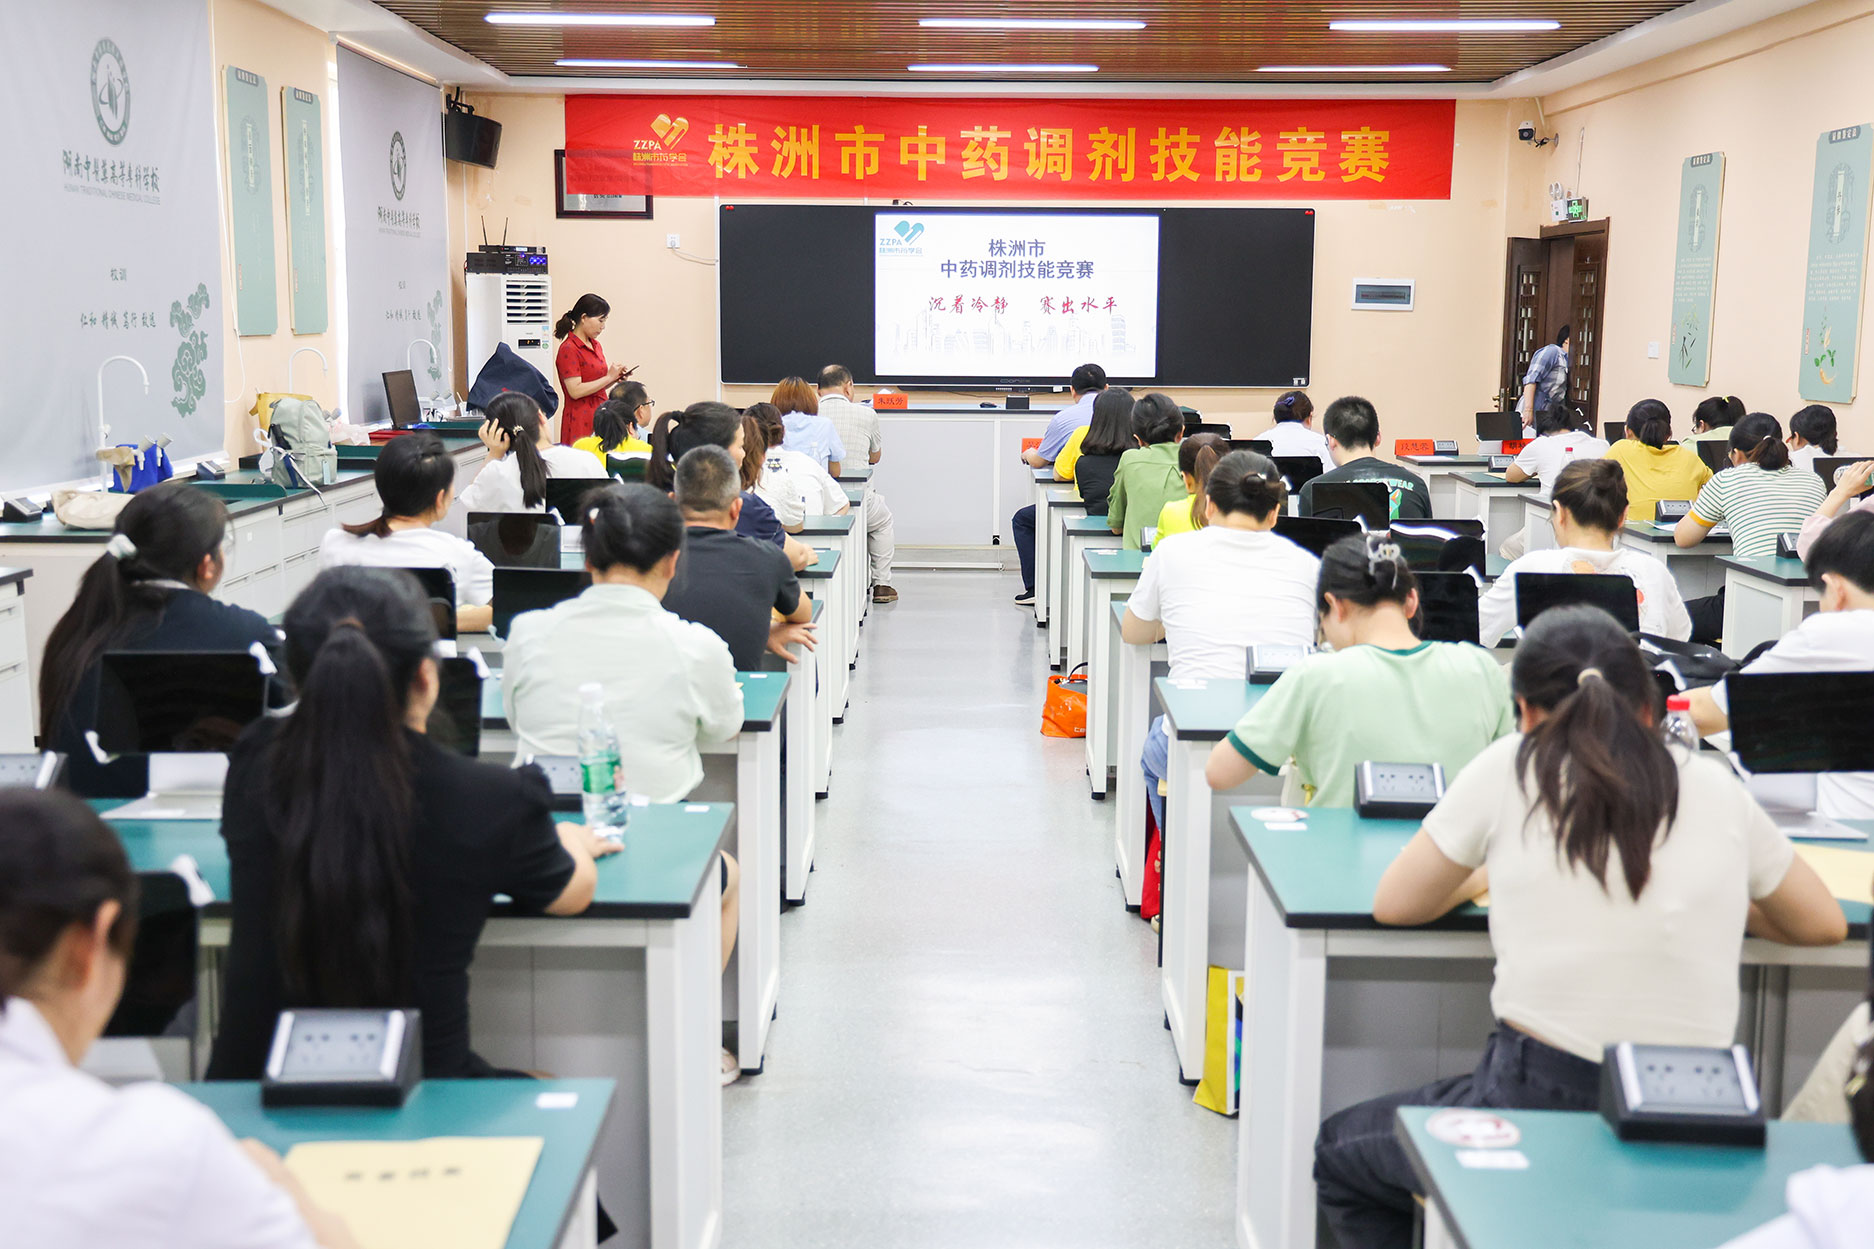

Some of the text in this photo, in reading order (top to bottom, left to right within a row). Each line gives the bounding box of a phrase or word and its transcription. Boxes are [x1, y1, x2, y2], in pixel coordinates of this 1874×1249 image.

[633, 140, 662, 151] ZZPA
[708, 122, 1390, 183] 株洲市中药调剂技能竞赛
[879, 238, 903, 247] ZZPA
[988, 238, 1047, 258] 株洲市
[940, 259, 1095, 280] 中药调剂技能竞赛
[928, 294, 1118, 316] 沉着冷静 赛出水平
